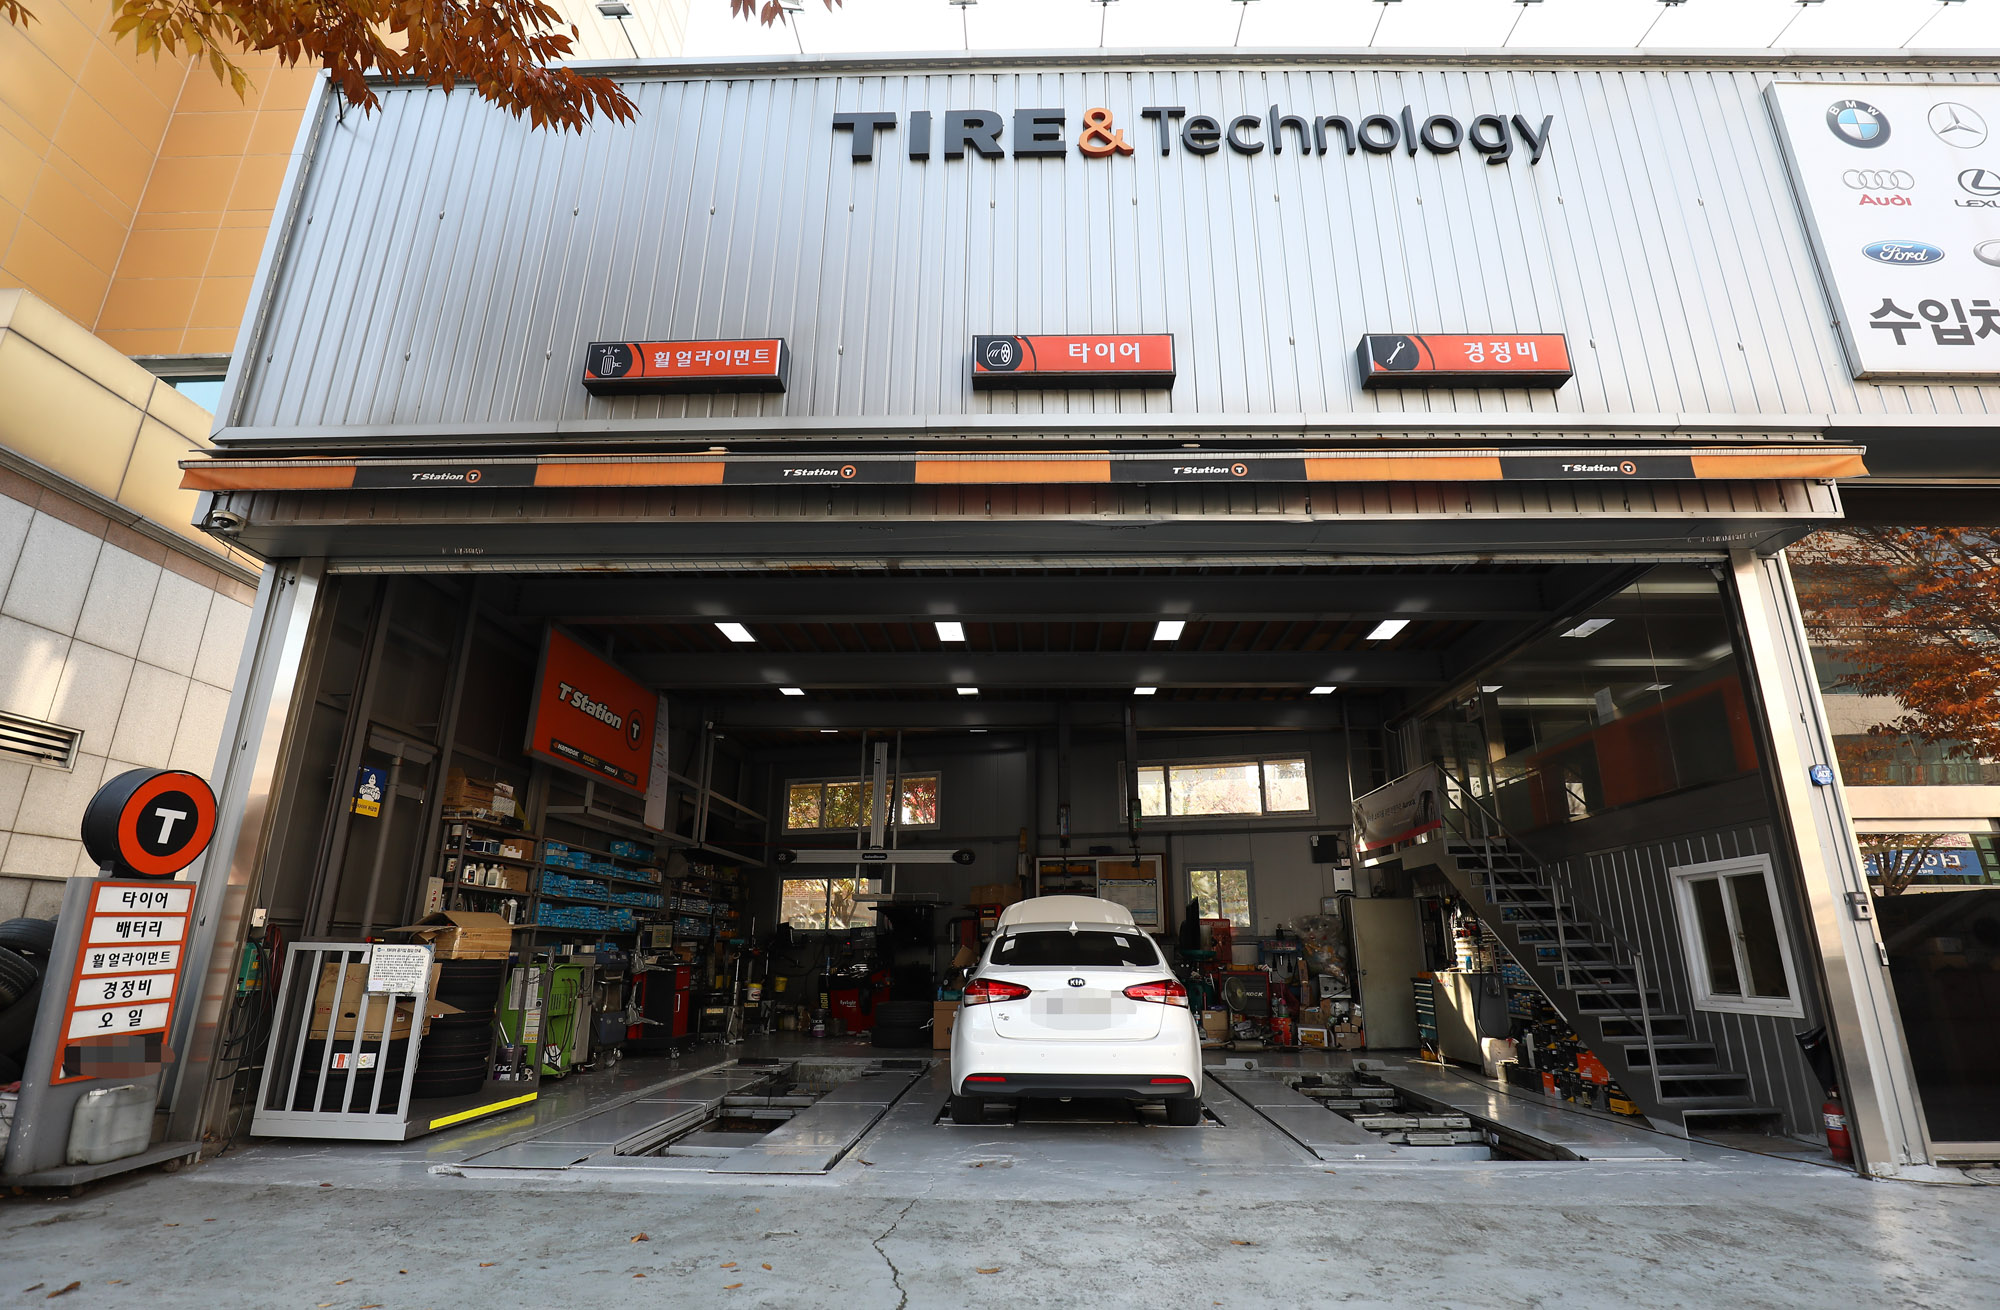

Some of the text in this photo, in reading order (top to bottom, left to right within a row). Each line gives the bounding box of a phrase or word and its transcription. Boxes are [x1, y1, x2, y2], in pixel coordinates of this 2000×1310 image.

[832, 108, 1067, 162] TIRE
[1141, 104, 1554, 165] Technology
[1858, 193, 1912, 207] Audi
[1879, 242, 1929, 262] Ford
[1068, 342, 1140, 364] 타이어
[1463, 341, 1539, 364] 경정비
[154, 807, 187, 845] T
[121, 891, 169, 910] 타이어
[115, 920, 163, 939] 배터리
[102, 979, 153, 1000] 경정비
